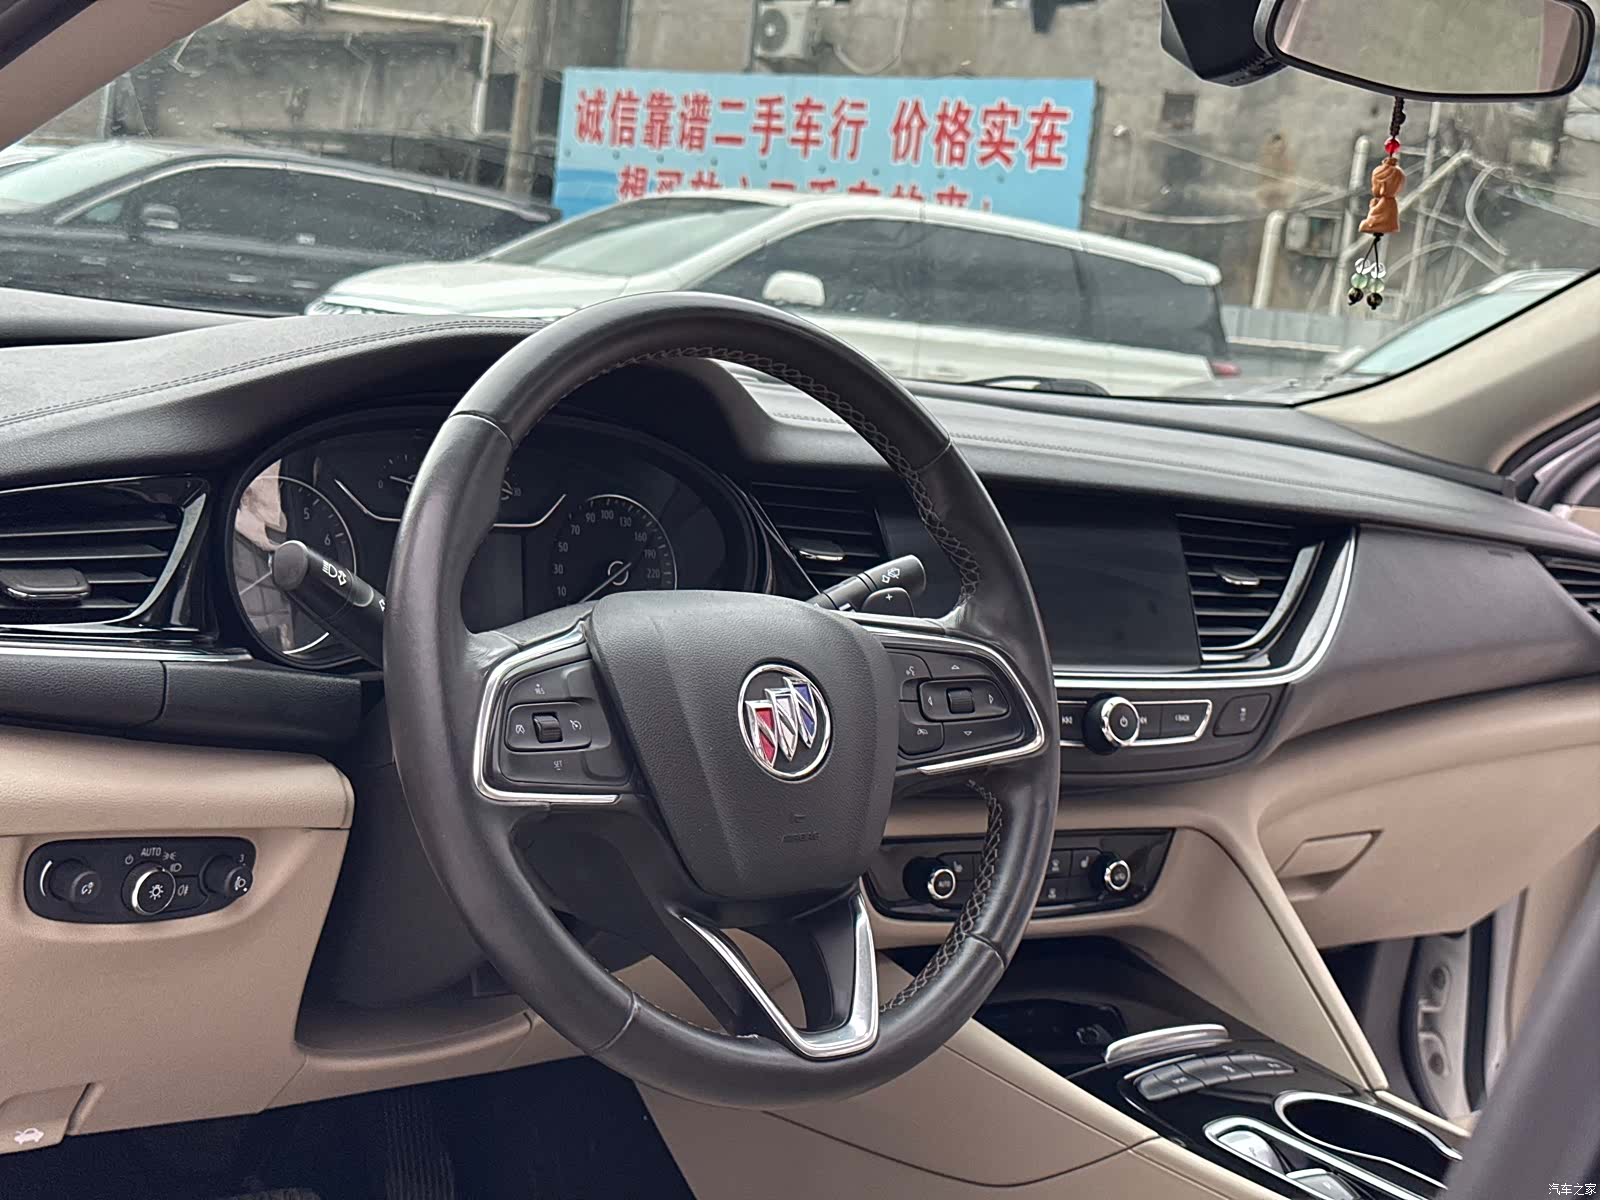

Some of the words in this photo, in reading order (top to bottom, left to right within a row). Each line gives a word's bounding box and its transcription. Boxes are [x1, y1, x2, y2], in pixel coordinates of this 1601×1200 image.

[576, 88, 868, 161] 诚信靠谱二手车行
[891, 99, 1070, 169] 价格实在
[303, 507, 311, 520] 5
[585, 513, 596, 523] 90
[601, 510, 614, 520] 100
[619, 516, 632, 527] 130
[571, 525, 581, 535] 70
[324, 533, 331, 546] 6
[634, 532, 648, 542] 160
[558, 542, 569, 552] 50
[644, 549, 657, 559] 190
[553, 564, 564, 574] 30
[646, 568, 661, 579] 220
[556, 586, 567, 597] 10
[140, 847, 162, 857] AUTO
